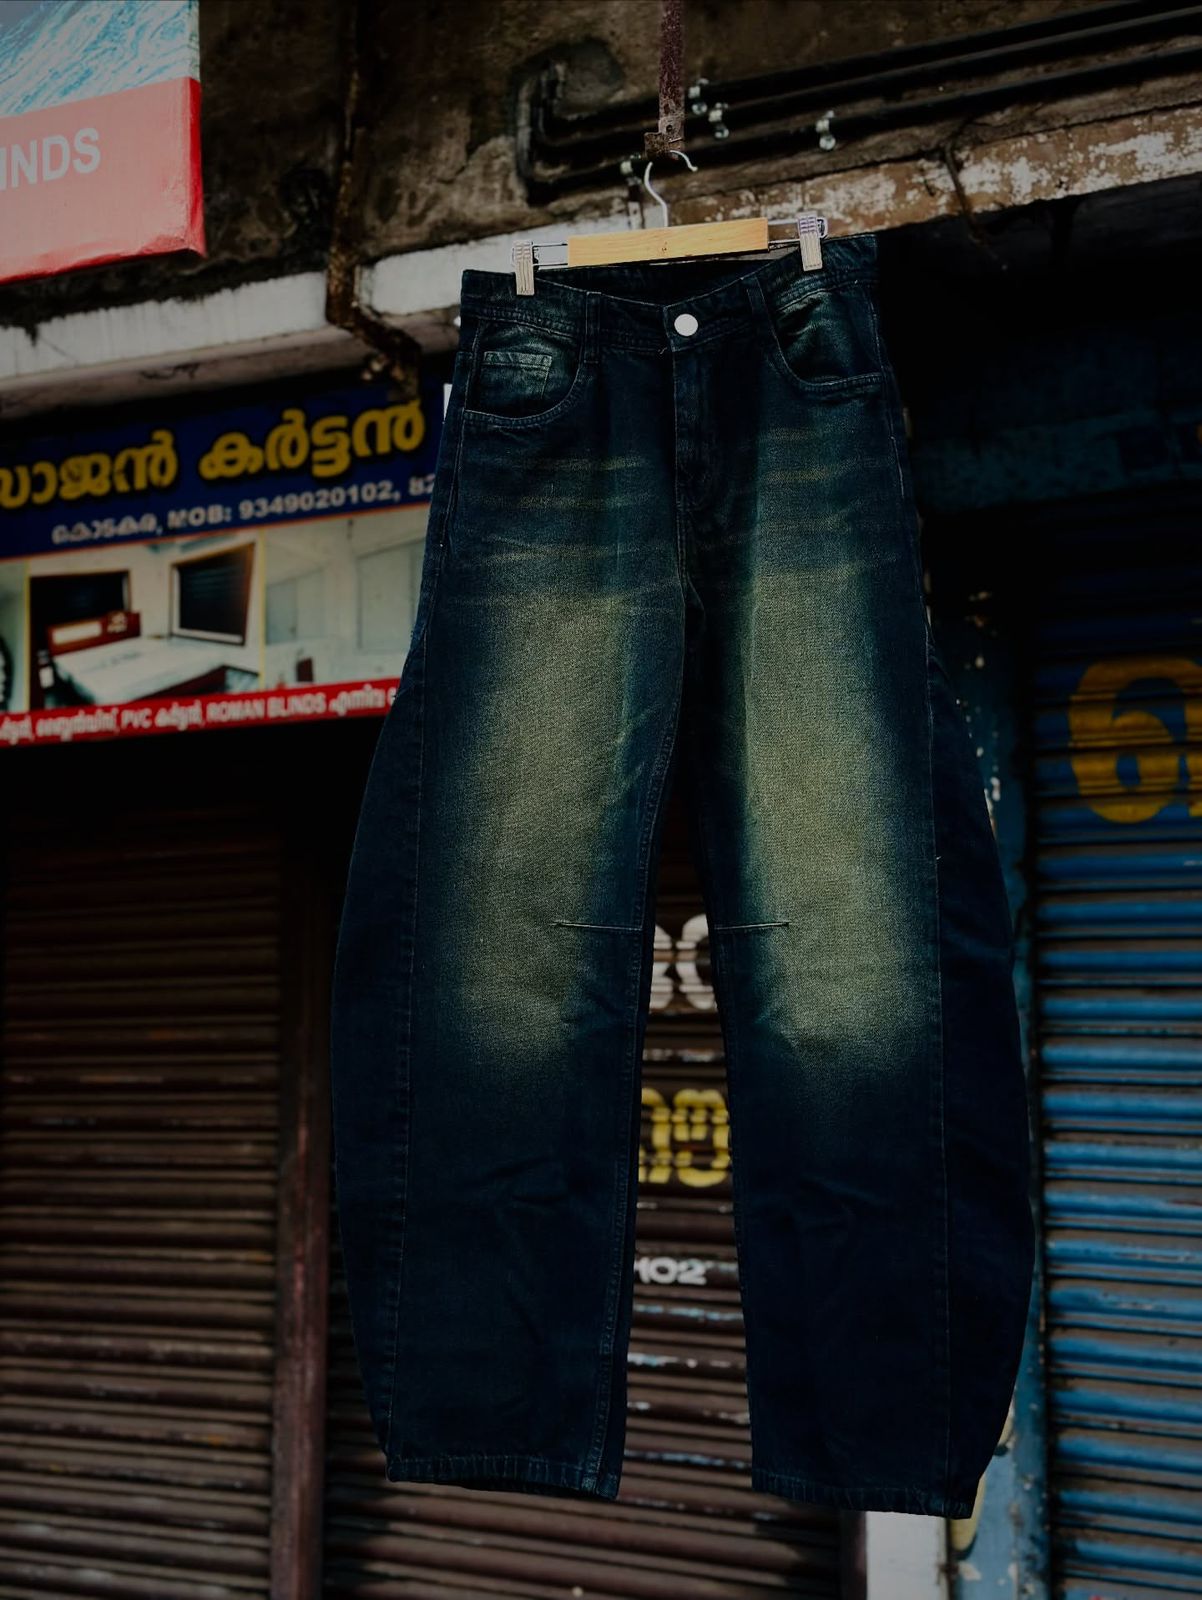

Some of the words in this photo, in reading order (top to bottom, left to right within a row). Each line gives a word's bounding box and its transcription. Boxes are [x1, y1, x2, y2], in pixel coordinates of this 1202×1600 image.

[166, 503, 233, 531] MOB:
[238, 480, 402, 521] 9349020102,
[120, 707, 153, 730] PVC
[206, 698, 265, 723] ROMAN
[267, 691, 327, 720] BLINDS
